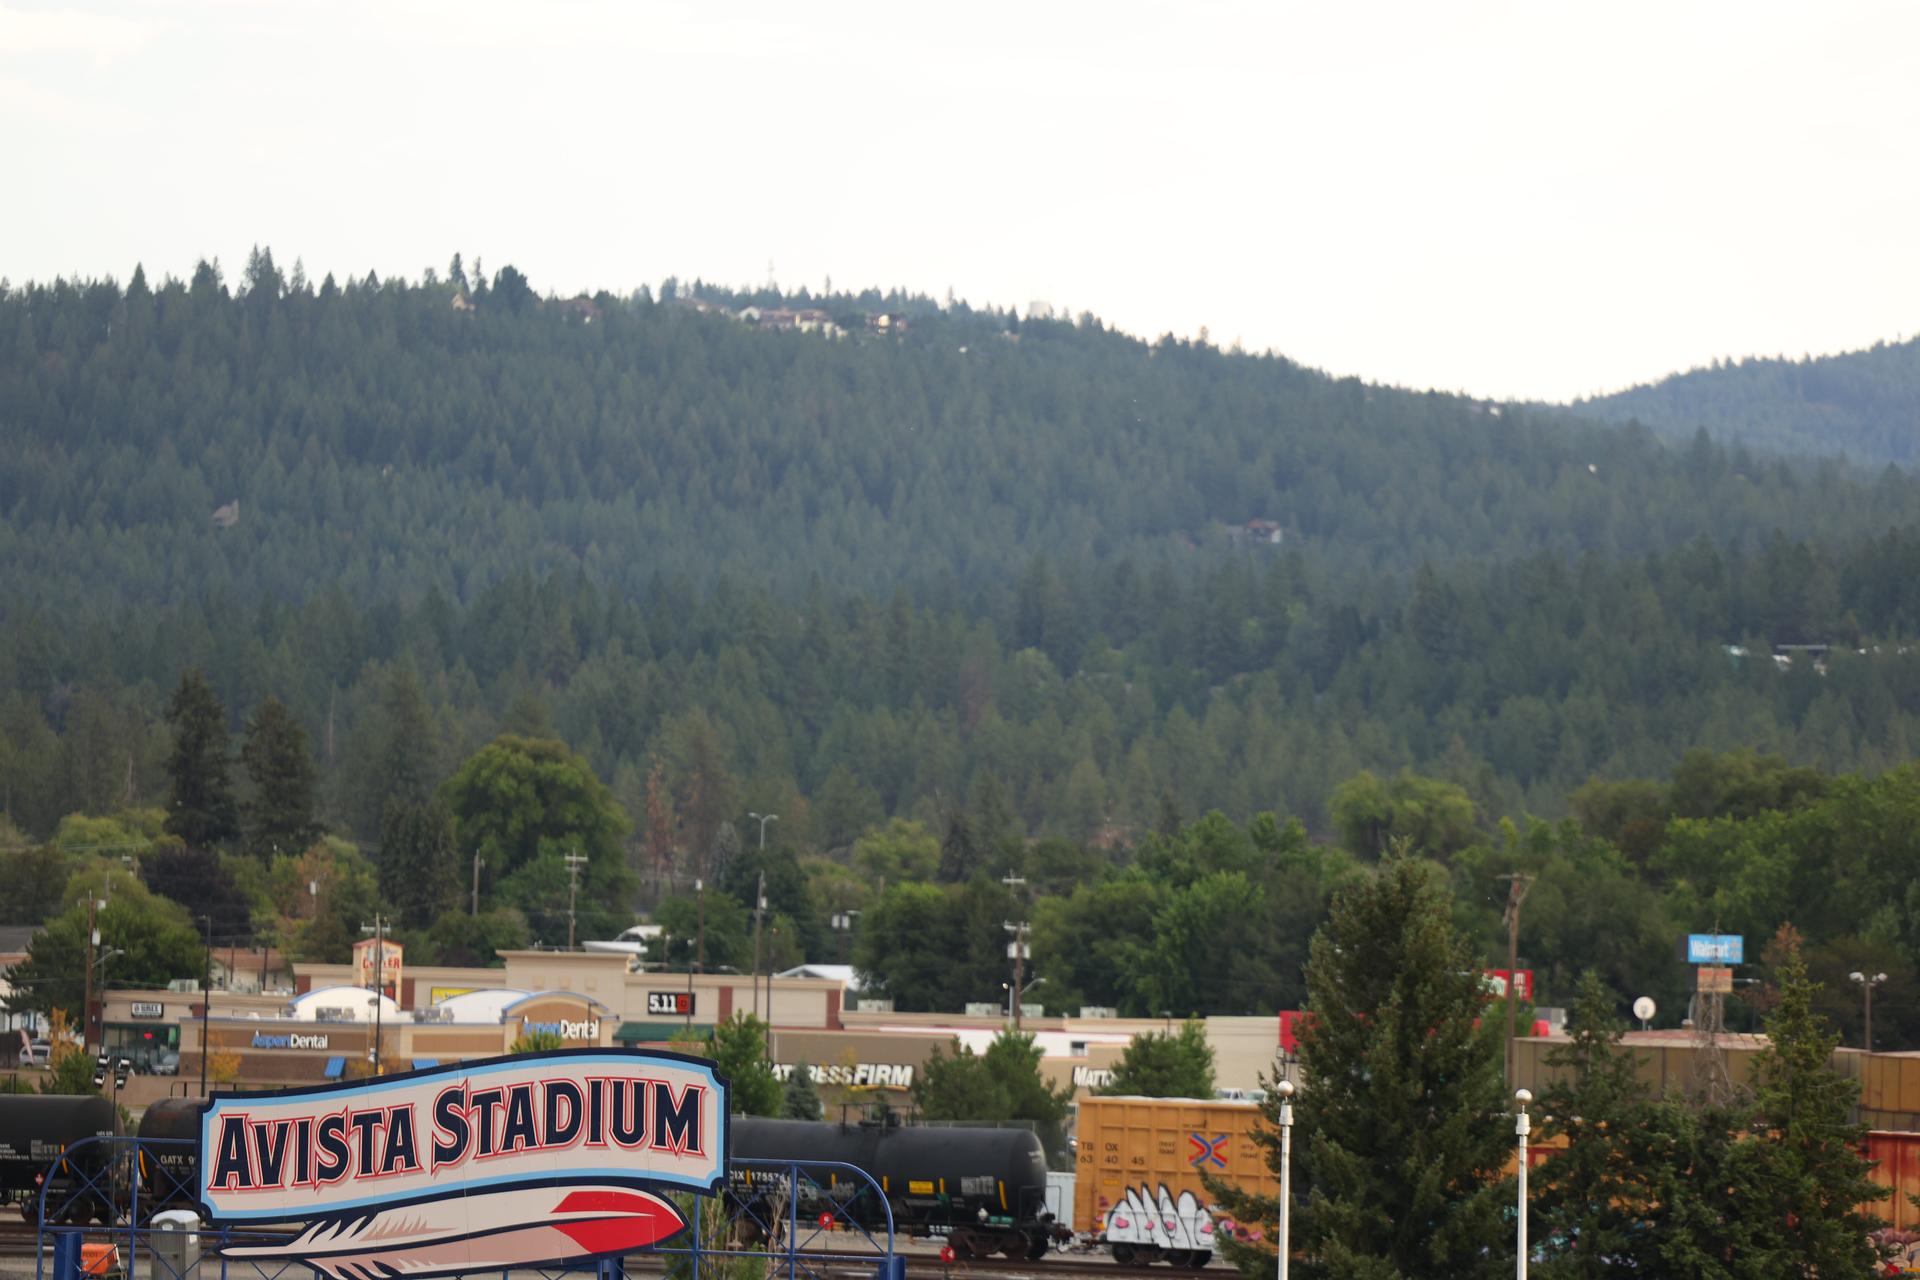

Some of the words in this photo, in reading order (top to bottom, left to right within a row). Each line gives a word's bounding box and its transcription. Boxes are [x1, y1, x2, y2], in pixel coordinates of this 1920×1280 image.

[649, 994, 677, 1014] 5.11
[207, 1102, 424, 1191] AVISTA
[431, 1076, 706, 1176] STADIUM
